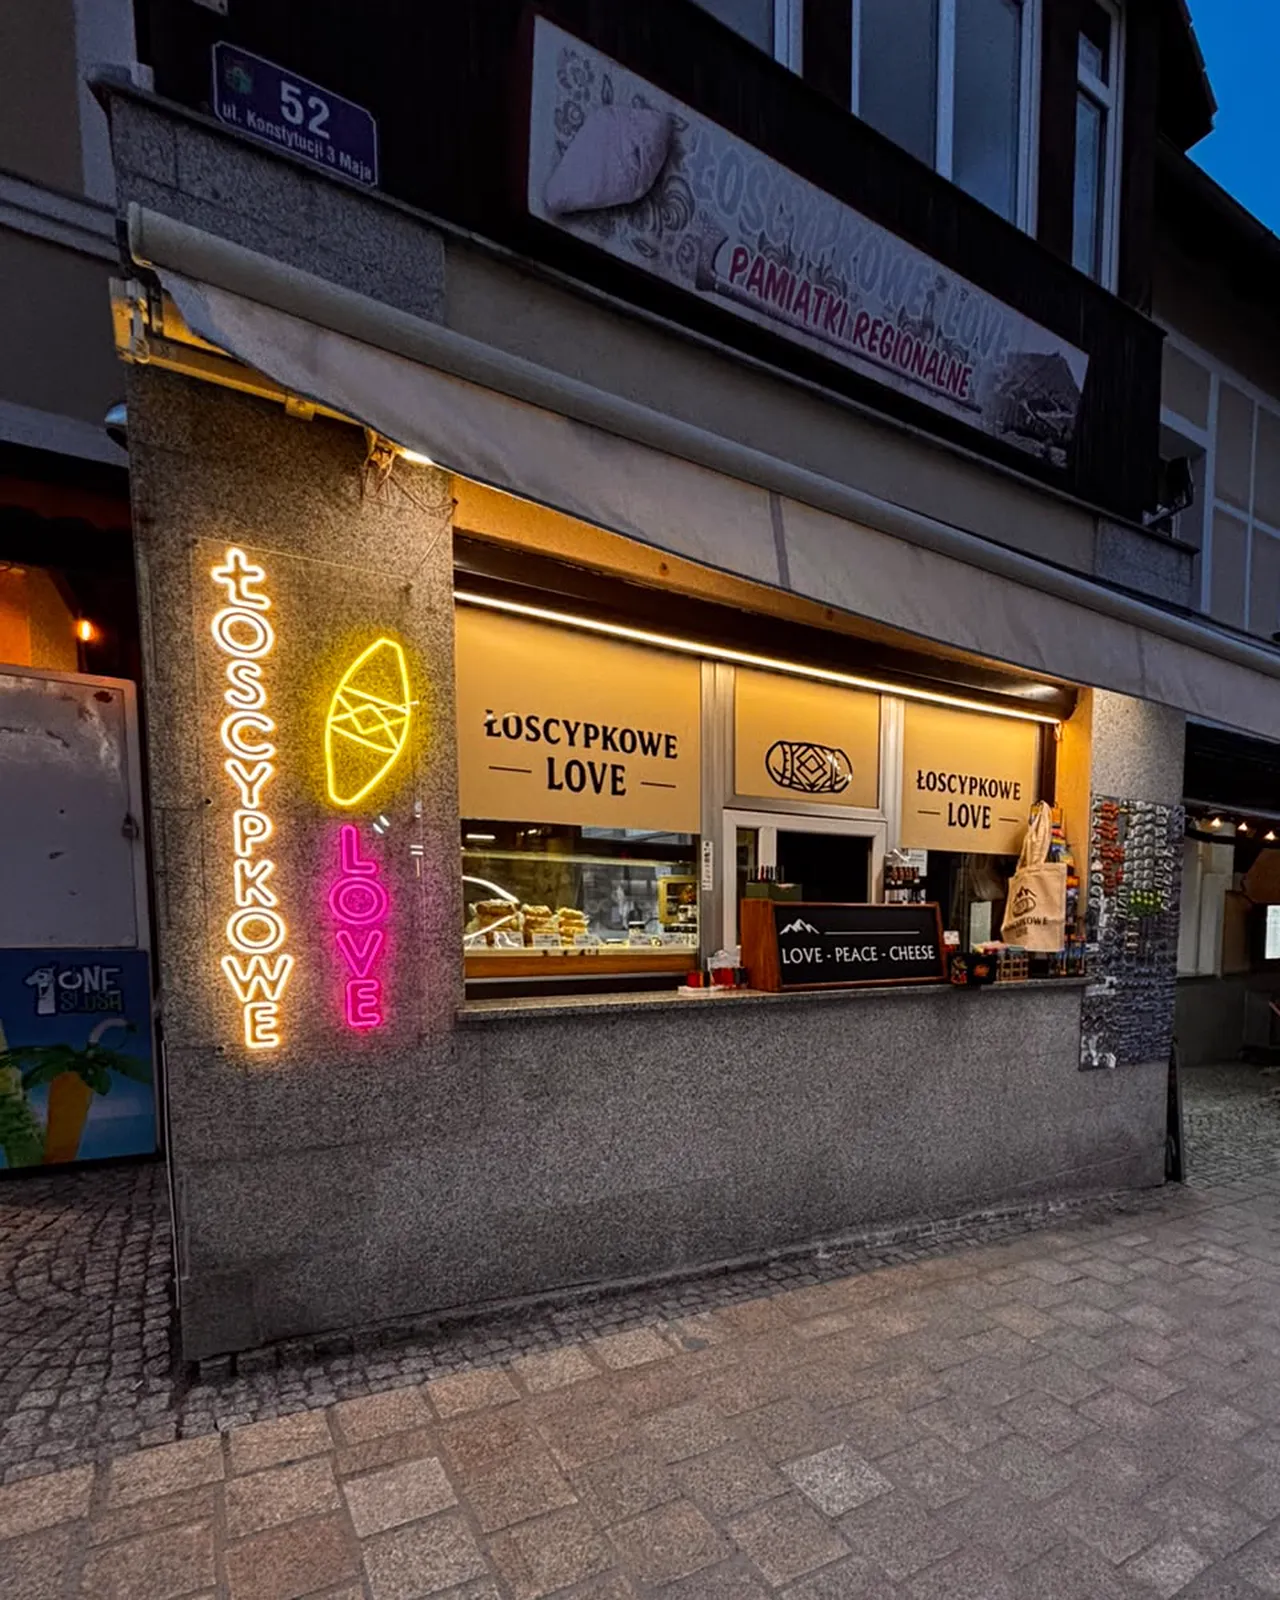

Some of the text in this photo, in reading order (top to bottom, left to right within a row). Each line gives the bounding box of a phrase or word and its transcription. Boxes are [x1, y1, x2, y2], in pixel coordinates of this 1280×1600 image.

[280, 80, 331, 140] 52
[222, 103, 373, 181] ul. Konstytucji 3 Maja
[942, 282, 1011, 365] LOVE
[853, 310, 973, 398] REGIONALNE
[484, 709, 679, 760] ŁOSCYPKOWE
[546, 756, 626, 796] LOVE
[916, 769, 1021, 801] ŁOSCYPKOWE
[947, 802, 992, 830] LOVE
[328, 824, 390, 1030] LOVE
[58, 965, 122, 993] ONE
[782, 945, 936, 964] LOVE PEACE CHEESE
